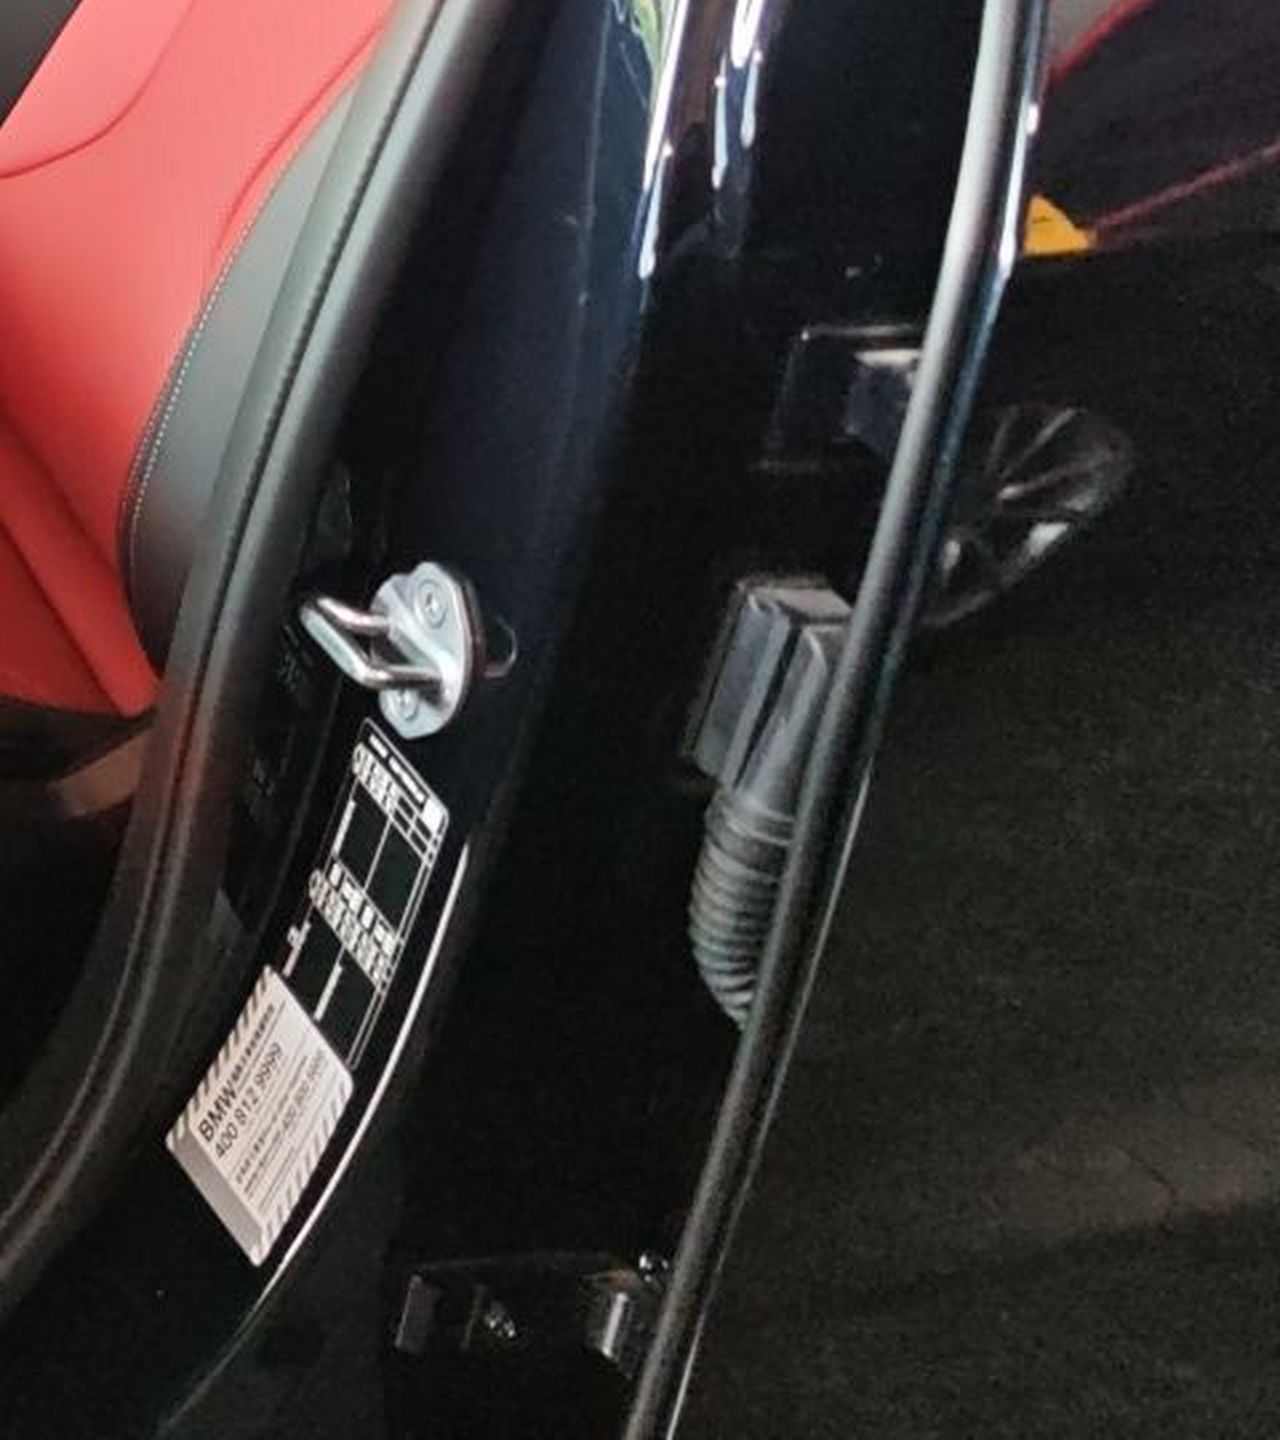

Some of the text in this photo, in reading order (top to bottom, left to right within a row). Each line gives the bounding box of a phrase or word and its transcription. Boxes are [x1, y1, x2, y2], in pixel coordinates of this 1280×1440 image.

[199, 1081, 237, 1142] BMW
[215, 1122, 239, 1158] 400
[234, 1087, 258, 1124] 812
[254, 1041, 282, 1091] 9999
